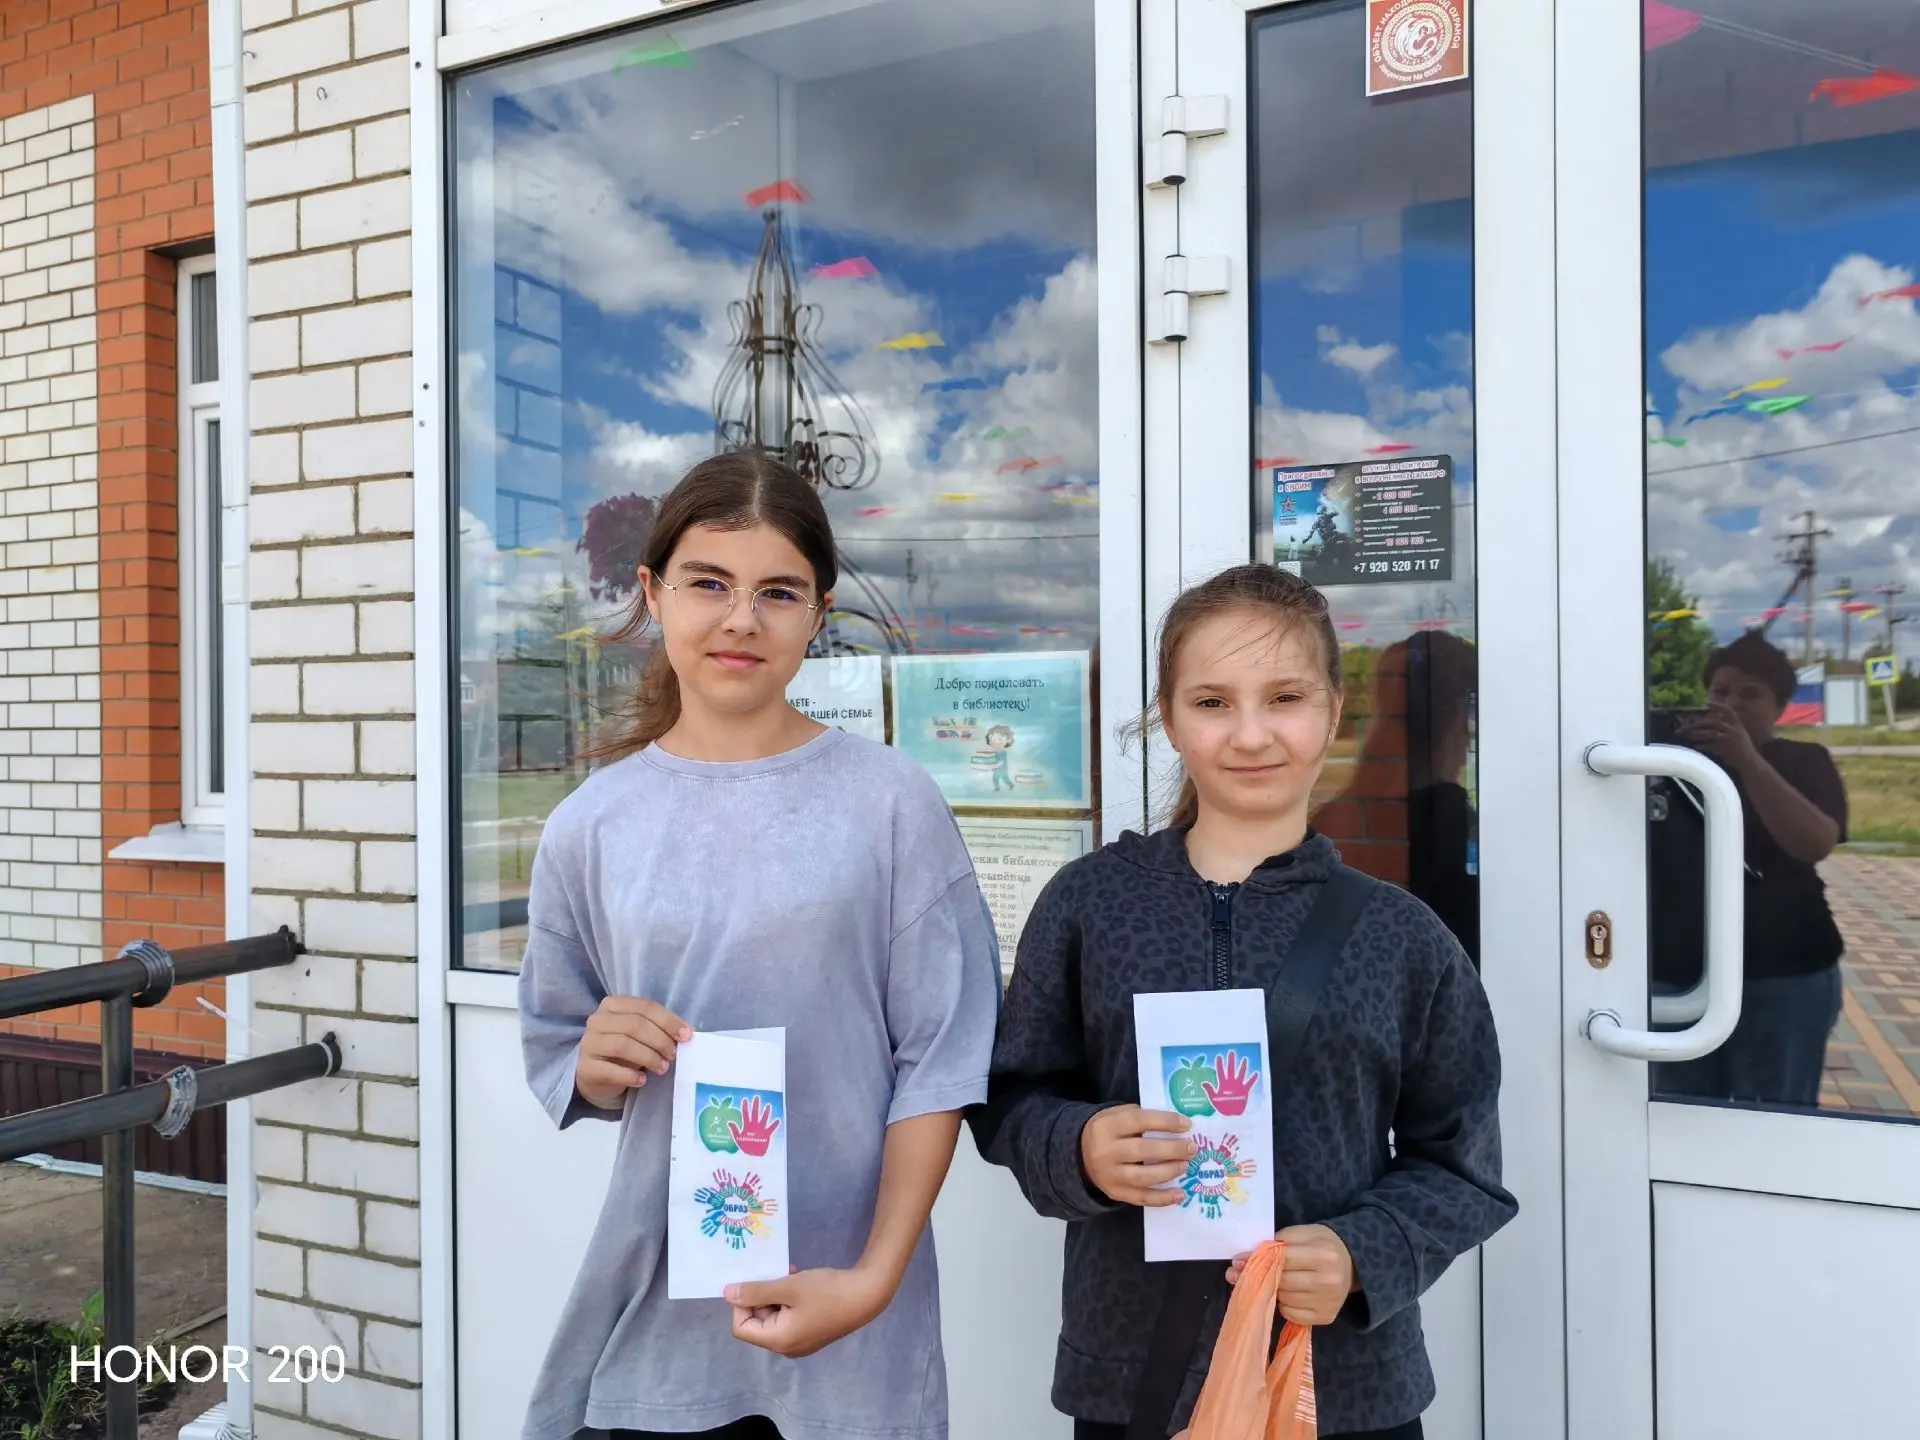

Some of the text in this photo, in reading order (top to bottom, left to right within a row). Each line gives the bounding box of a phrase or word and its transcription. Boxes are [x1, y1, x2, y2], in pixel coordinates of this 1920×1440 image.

[1372, 26, 1383, 63] ОБЪЕКТ
[1448, 7, 1462, 49] ОХРАНОЙ
[1278, 469, 1335, 482] Присоединяйся
[1353, 559, 1440, 573] +7 920 520 71 17
[935, 677, 1045, 692] Добро пожаловать
[789, 698, 810, 708] АЕТЕ
[953, 698, 1030, 712] в библиотеку!
[840, 708, 873, 719] СЕМЬЕ
[973, 854, 1068, 868] ская библиотек
[1198, 1169, 1225, 1180] ОБРАЗ
[723, 1203, 748, 1214] ОБРАЗ
